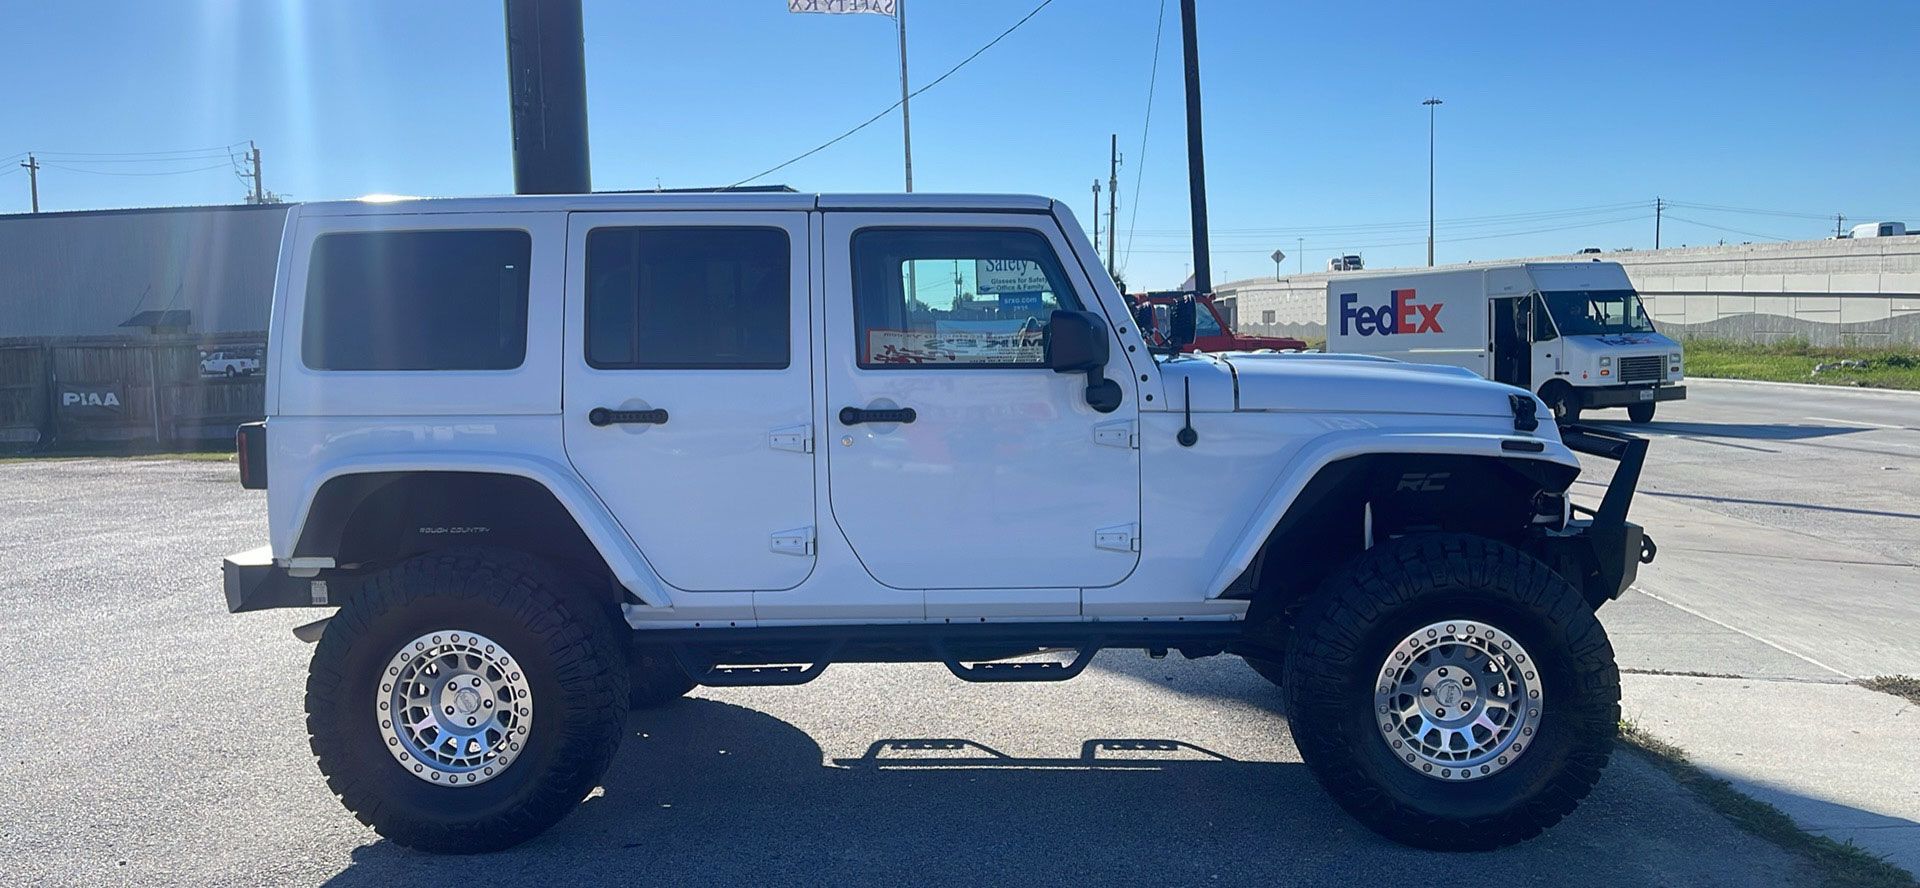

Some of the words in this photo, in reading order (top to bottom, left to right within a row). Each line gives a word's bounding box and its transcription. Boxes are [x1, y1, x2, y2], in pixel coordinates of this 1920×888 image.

[1340, 288, 1444, 336] FedEx
[63, 392, 120, 406] PIAA
[1396, 472, 1451, 491] RC
